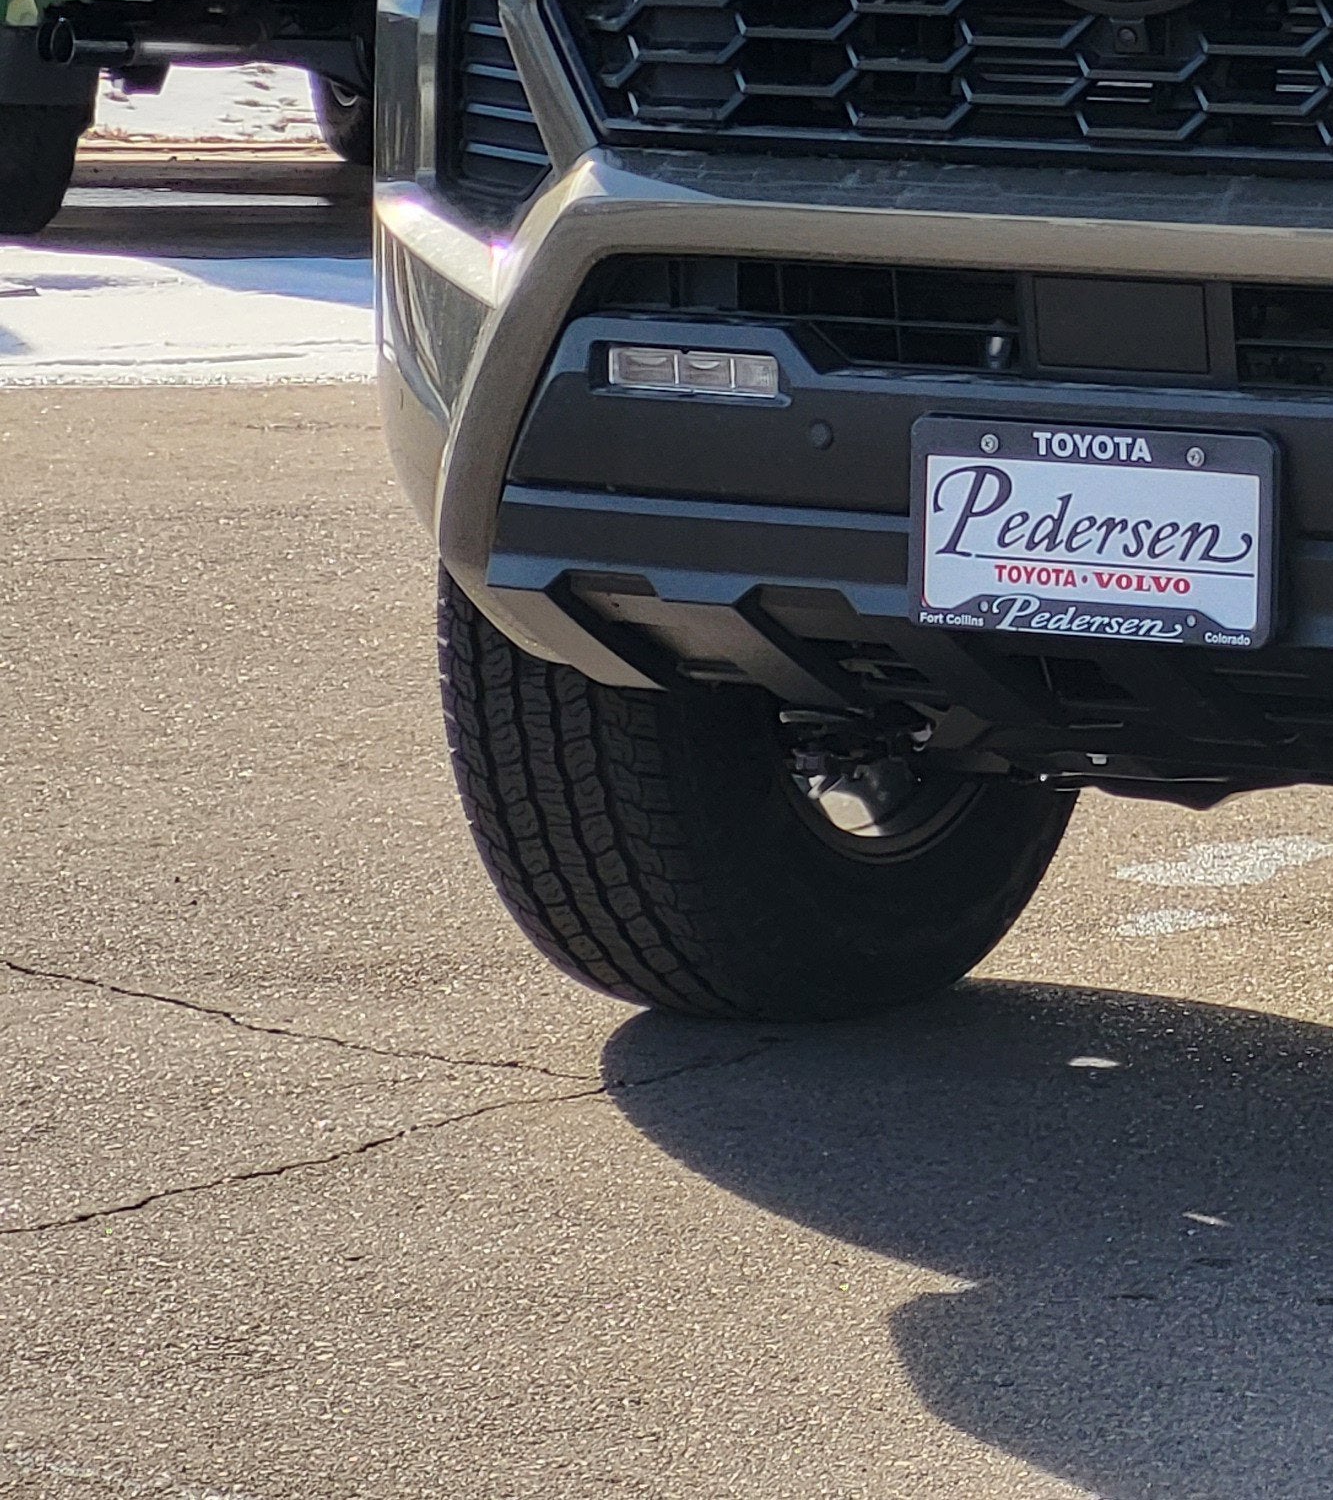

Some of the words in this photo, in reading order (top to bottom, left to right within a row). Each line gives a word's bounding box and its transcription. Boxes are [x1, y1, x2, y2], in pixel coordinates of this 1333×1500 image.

[1032, 431, 1153, 463] TOYOTA
[932, 465, 1254, 564] Pedersen
[994, 564, 1078, 588] TOYOTA
[1093, 571, 1192, 595] VOLVO
[919, 611, 944, 625] Fort
[945, 612, 984, 627] Collins
[991, 594, 1184, 638] Pedersen
[1204, 631, 1252, 647] Colorado
